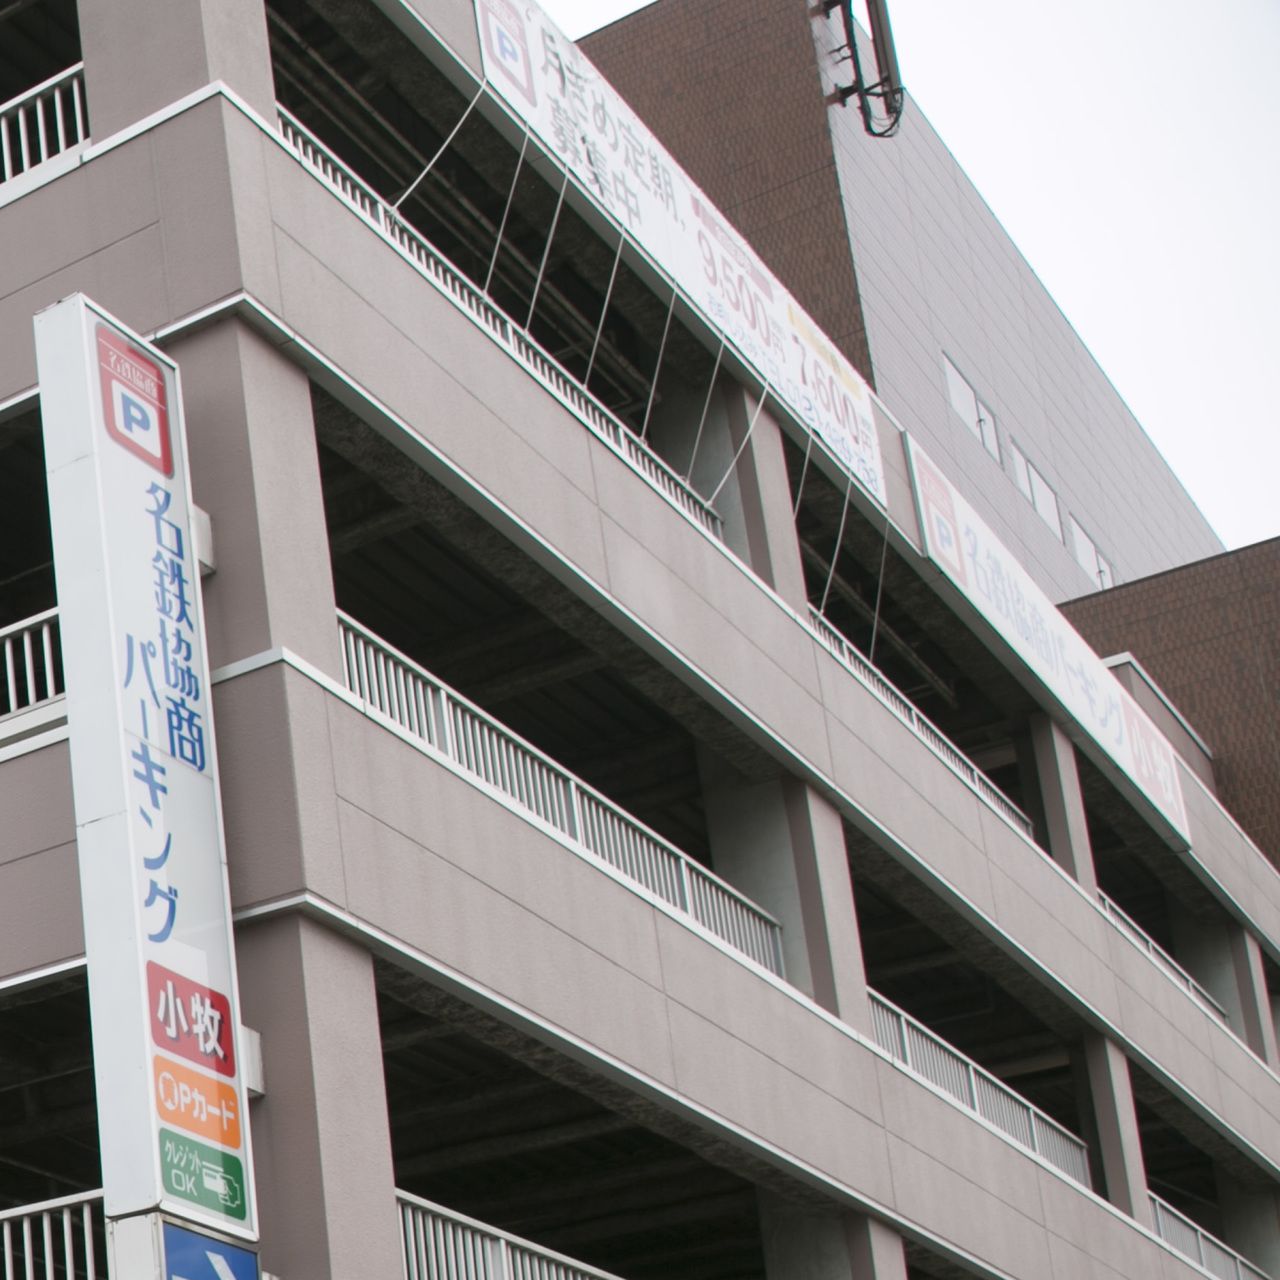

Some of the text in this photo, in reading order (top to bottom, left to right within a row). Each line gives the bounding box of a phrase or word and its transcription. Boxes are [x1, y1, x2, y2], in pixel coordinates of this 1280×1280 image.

[121, 392, 151, 433] P
[145, 480, 206, 773] 名鉄協商
[124, 633, 178, 943] パーキング
[157, 980, 227, 1060] 小牧
[166, 1140, 201, 1174] クレジット
[172, 1170, 197, 1196] OK
